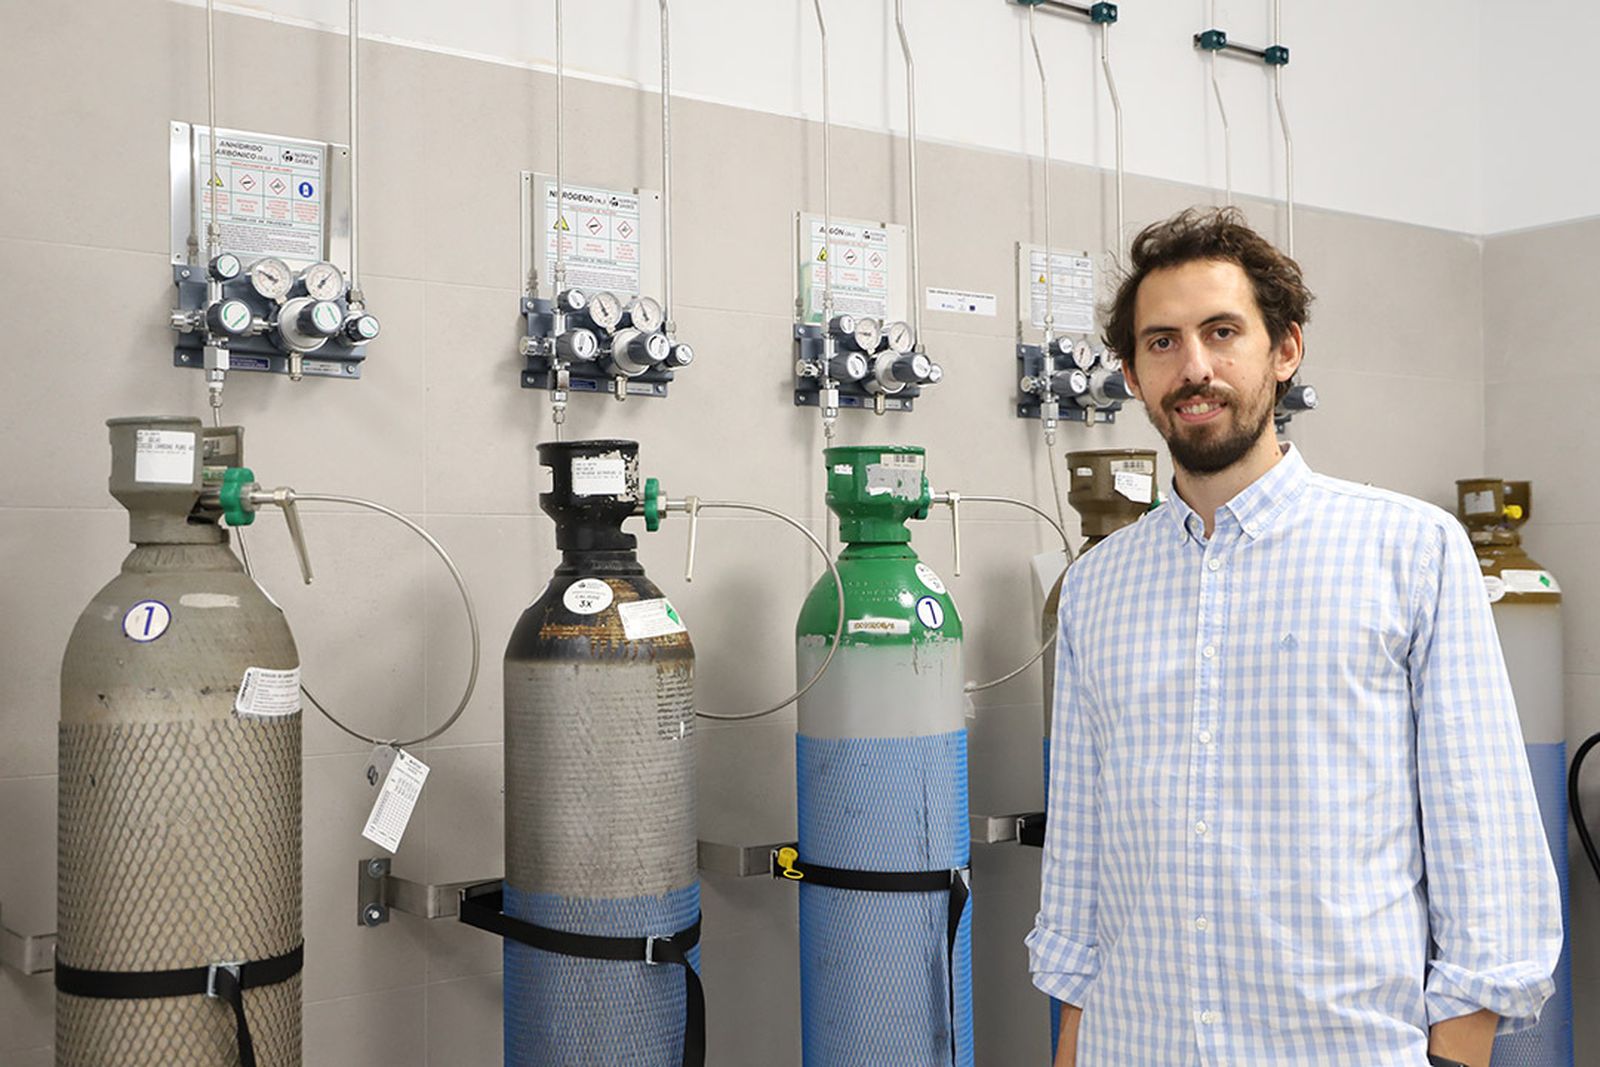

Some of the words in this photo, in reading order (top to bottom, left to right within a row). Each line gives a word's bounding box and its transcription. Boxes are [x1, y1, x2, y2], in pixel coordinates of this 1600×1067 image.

[215, 149, 256, 160] ARBÓNICO
[819, 226, 844, 236] AGÓN
[143, 606, 155, 636] 1
[925, 601, 938, 625] 1
